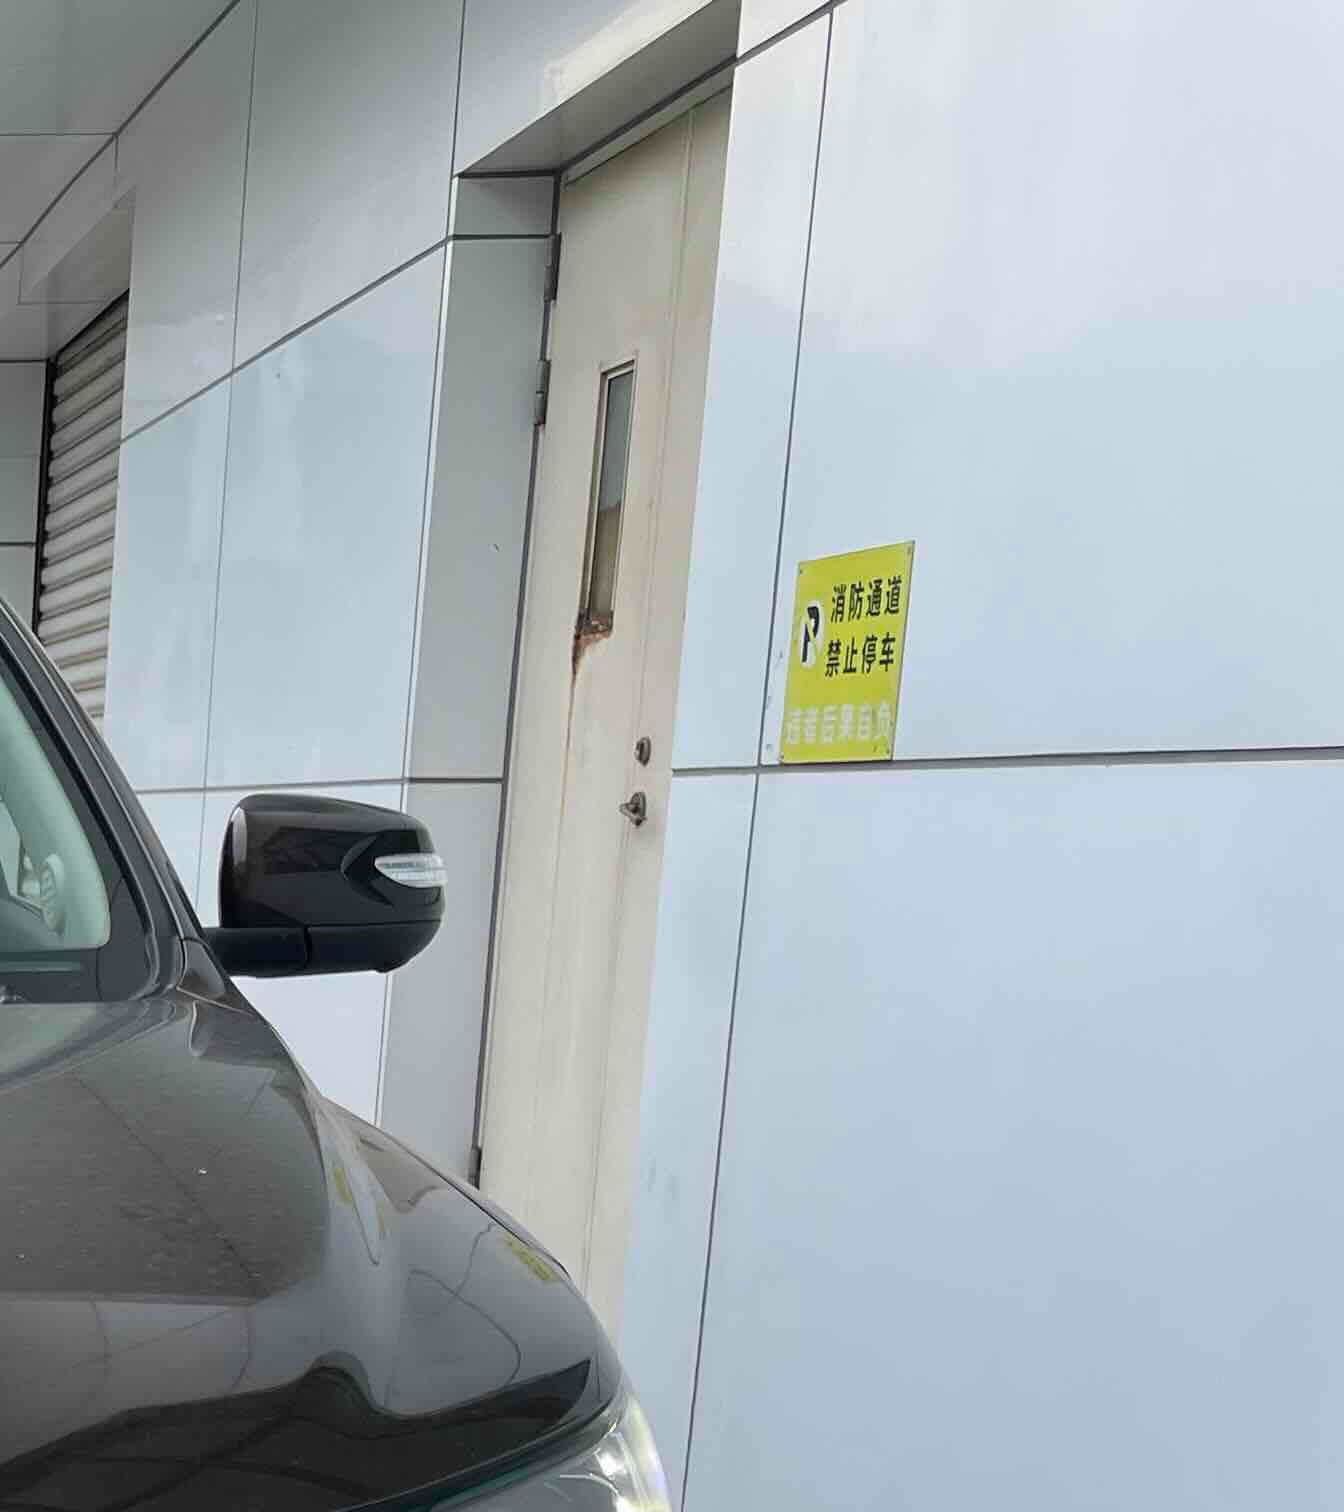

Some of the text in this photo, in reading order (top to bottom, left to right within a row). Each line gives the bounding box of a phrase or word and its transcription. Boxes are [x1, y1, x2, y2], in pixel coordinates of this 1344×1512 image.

[830, 575, 902, 623] 消防通道
[825, 632, 896, 677] 禁止停车
